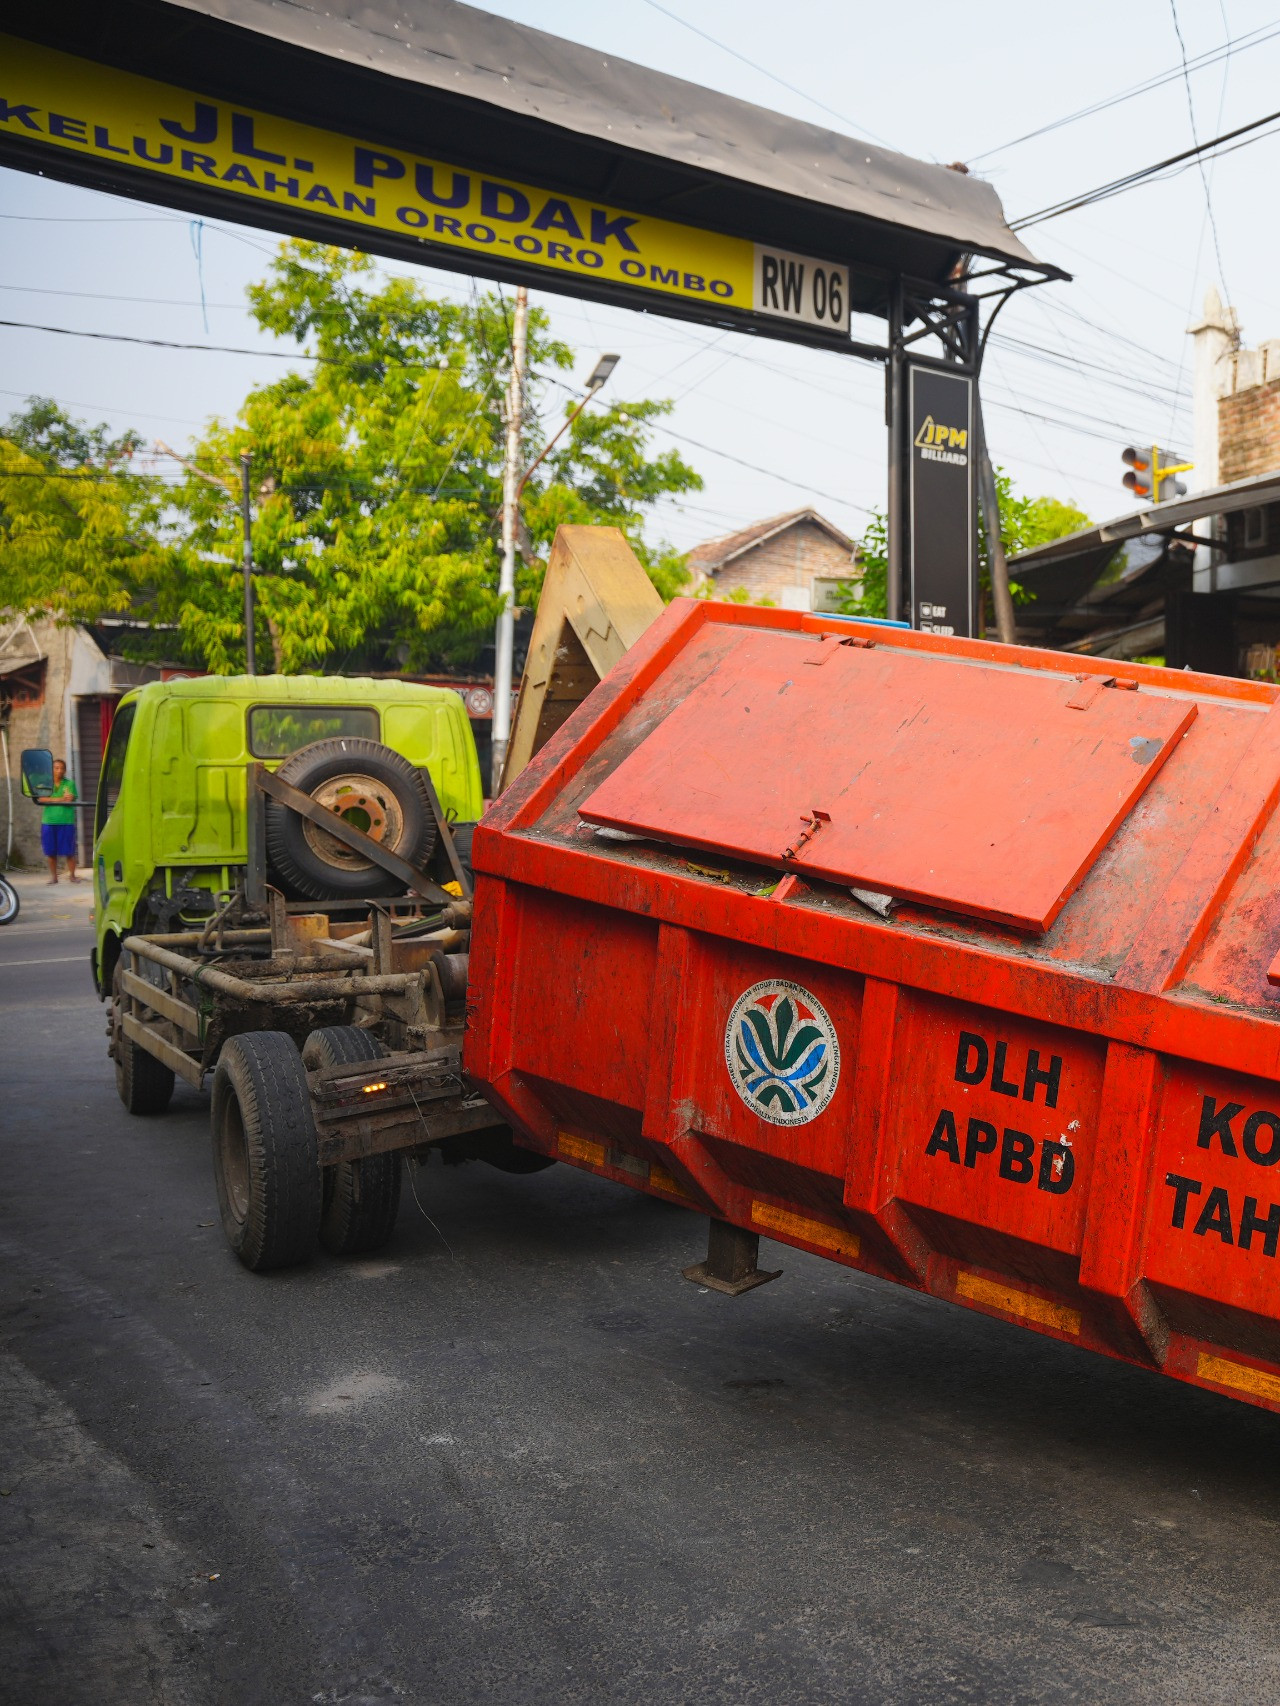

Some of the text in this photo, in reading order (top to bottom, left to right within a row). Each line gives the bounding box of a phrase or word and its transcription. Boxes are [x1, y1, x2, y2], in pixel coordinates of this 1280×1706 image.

[0, 97, 734, 298] KELURAHAN ORO-ORO OMBO
[159, 101, 641, 253] JL. PUDAK
[762, 254, 843, 323] RW 06
[921, 448, 968, 466] BILLIARD
[924, 423, 968, 449] JPM
[932, 605, 947, 618] EAT
[828, 1040, 840, 1093] LINGKUNGAN
[954, 1030, 1062, 1109] DLH
[772, 1115, 809, 1126] INDONESIA
[815, 1095, 831, 1115] HIDUP
[925, 1108, 1075, 1195] APBD
